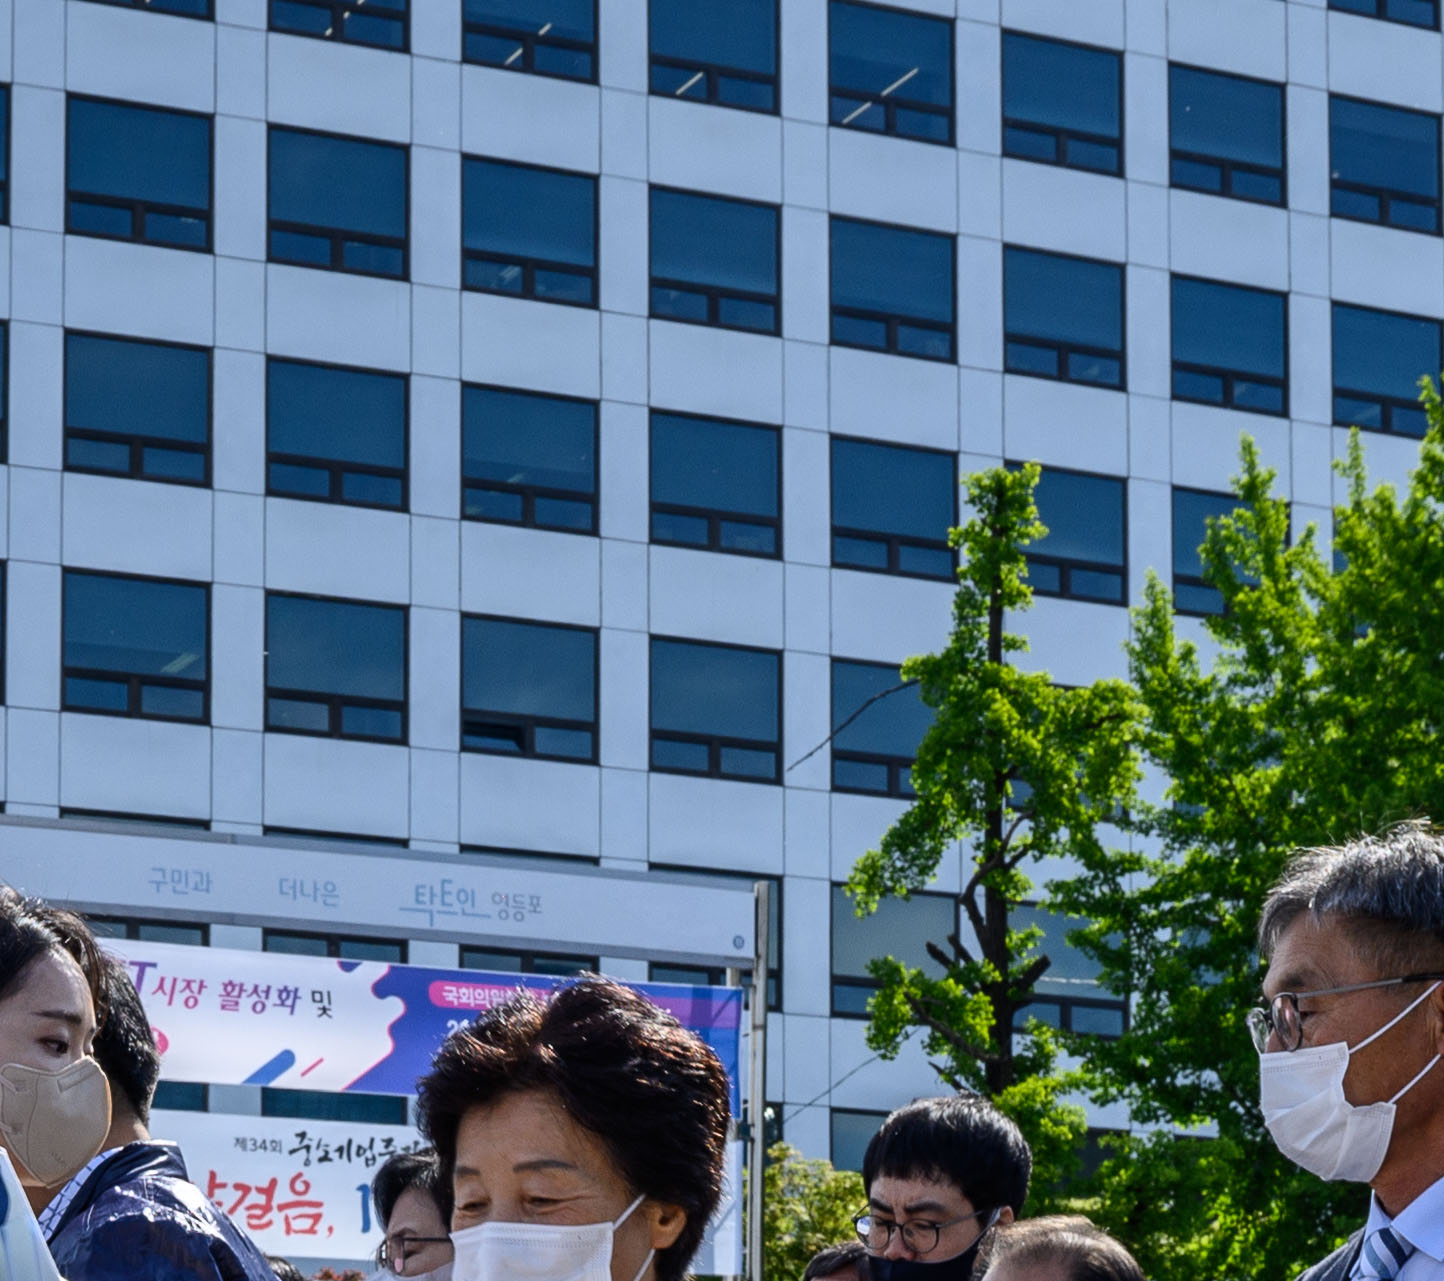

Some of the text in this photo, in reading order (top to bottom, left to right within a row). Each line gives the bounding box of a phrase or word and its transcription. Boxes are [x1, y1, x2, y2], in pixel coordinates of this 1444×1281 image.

[147, 866, 213, 895] 구민과
[277, 876, 341, 907] 더나은
[490, 891, 544, 922] 영등포
[127, 959, 334, 1020] T시장 활성화 및
[233, 1135, 283, 1155] 제34회
